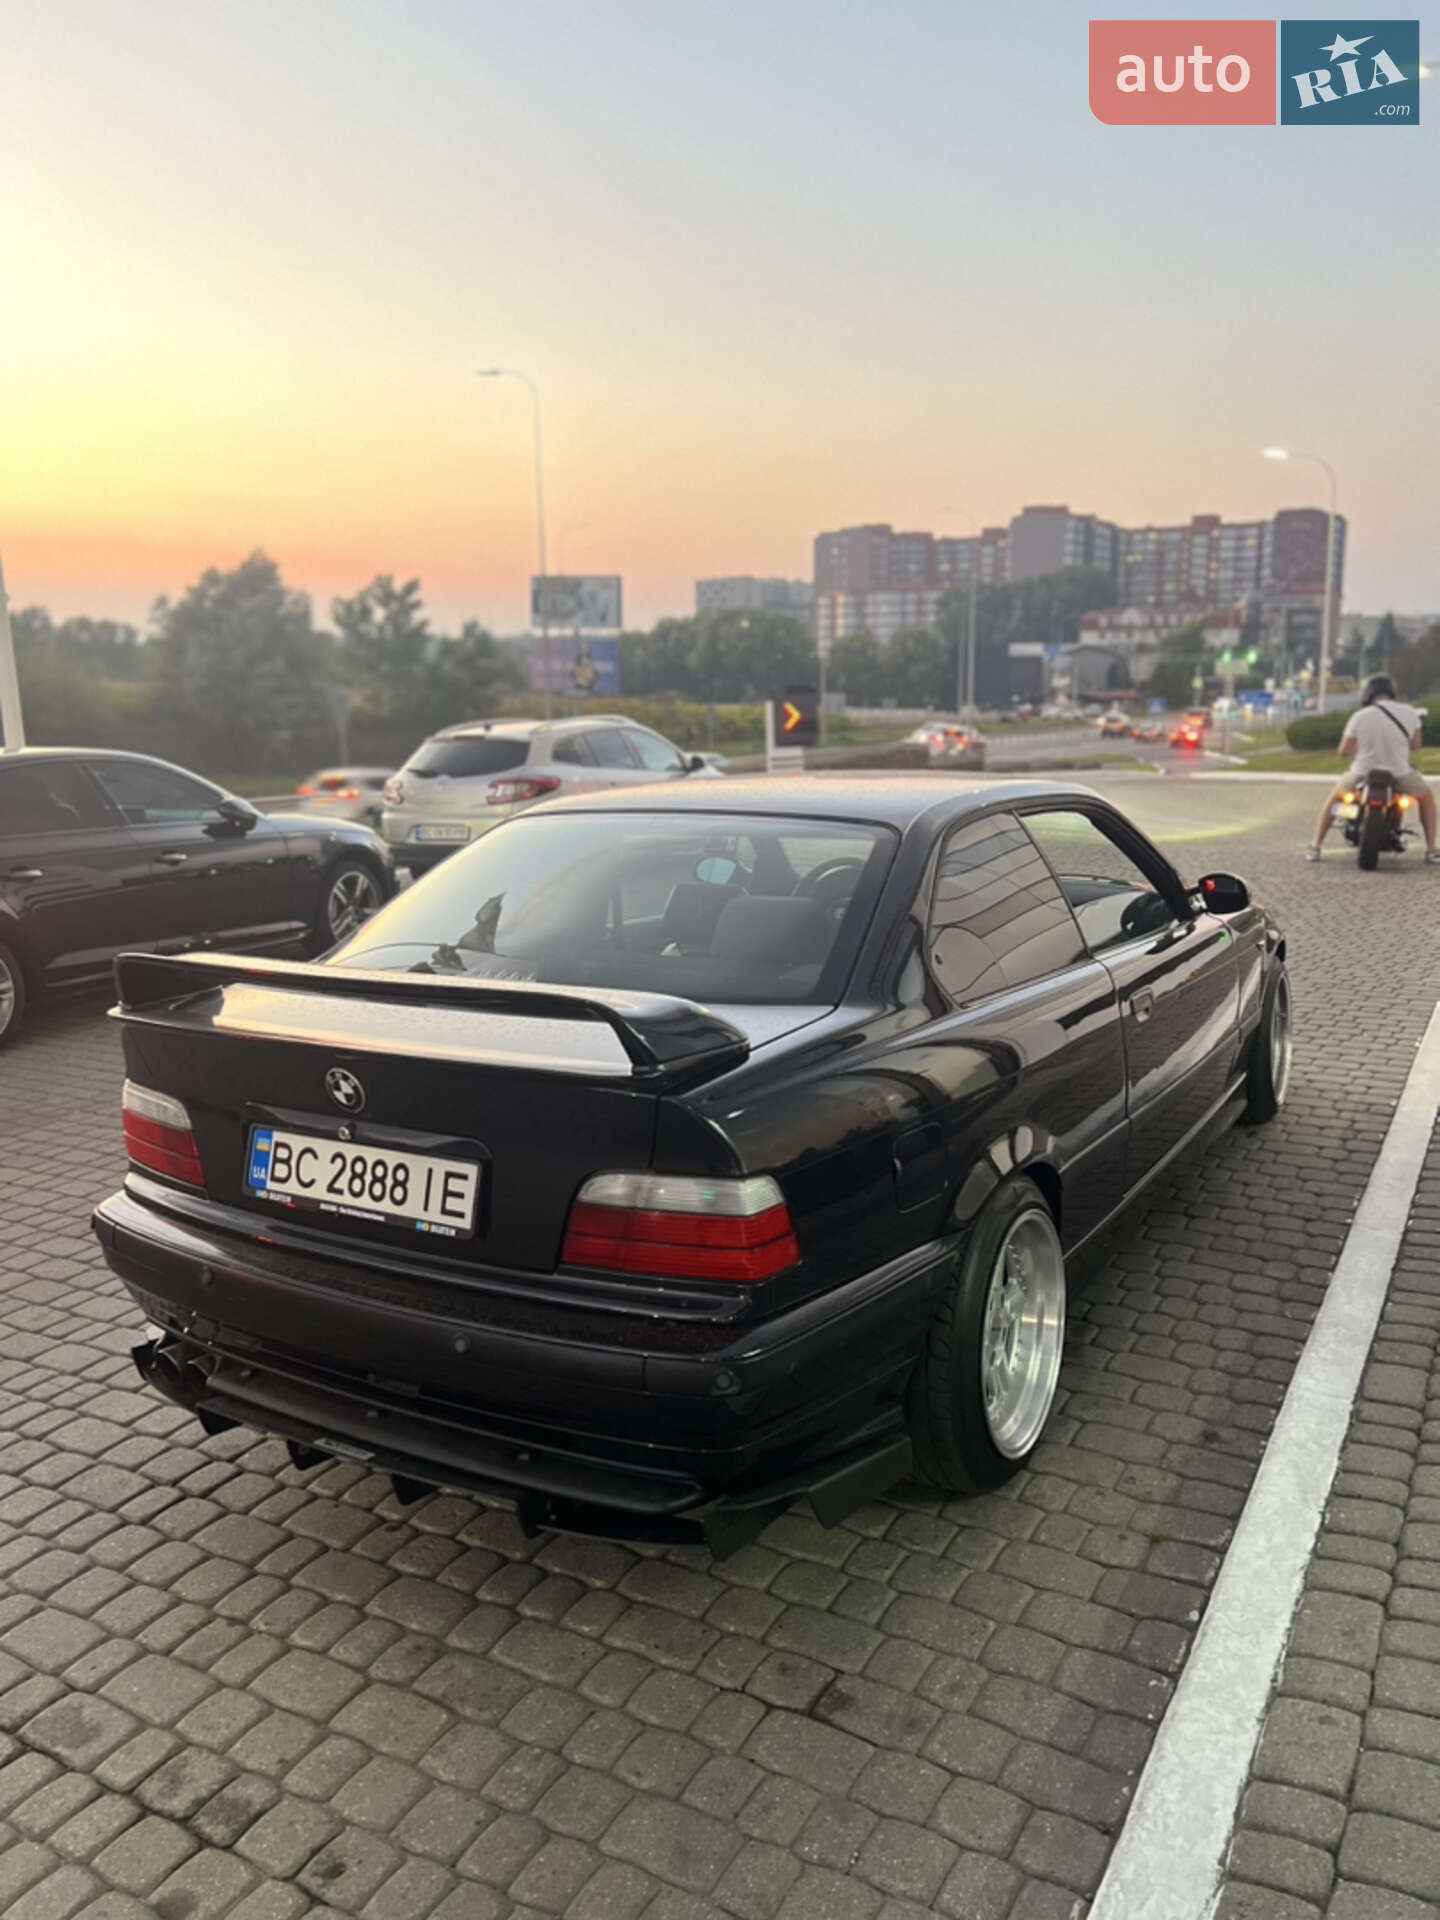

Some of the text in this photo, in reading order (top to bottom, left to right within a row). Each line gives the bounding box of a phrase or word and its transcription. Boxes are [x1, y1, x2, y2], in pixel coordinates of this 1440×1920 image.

[253, 1166, 267, 1180] UA
[269, 1141, 469, 1219] BC 2888 IE
